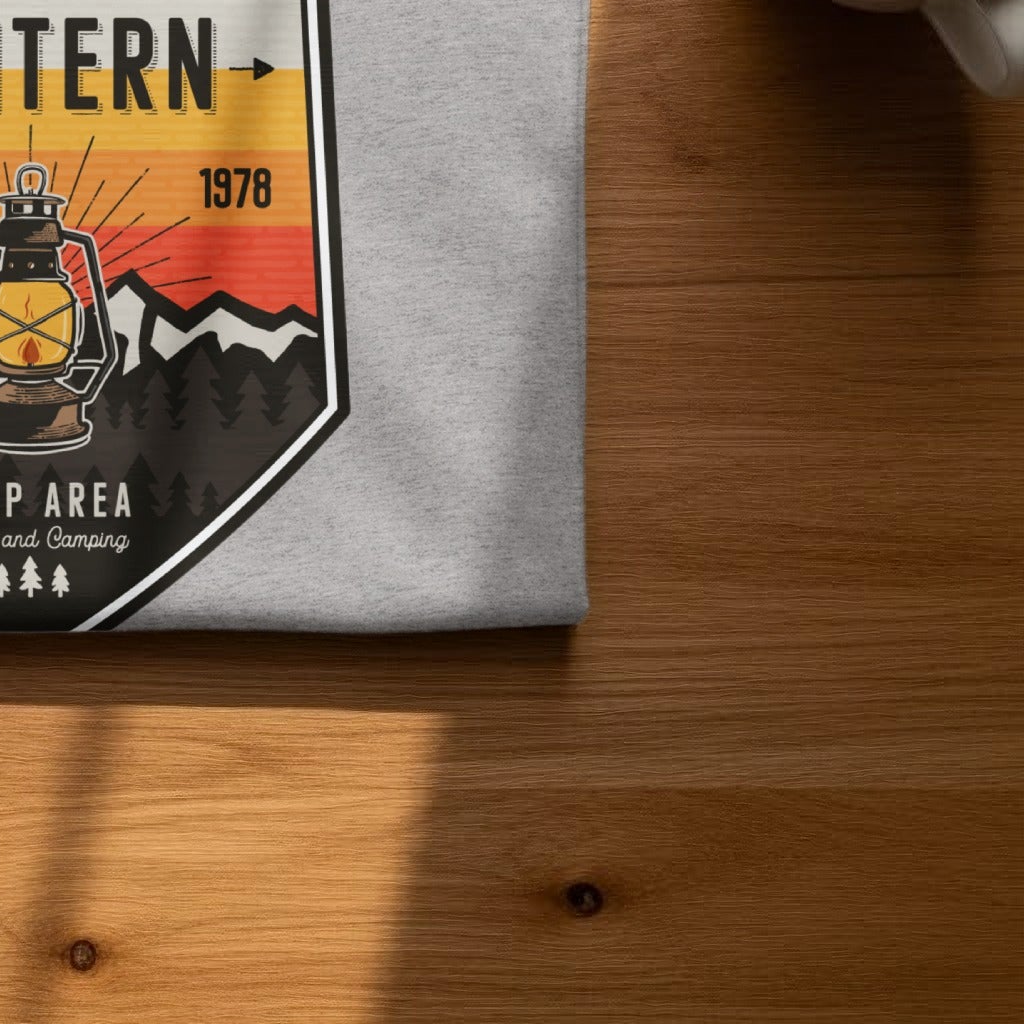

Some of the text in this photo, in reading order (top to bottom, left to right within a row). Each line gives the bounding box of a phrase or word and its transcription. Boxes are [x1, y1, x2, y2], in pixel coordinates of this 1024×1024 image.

[199, 168, 272, 209] 1978
[44, 482, 131, 517] AREA
[1, 529, 39, 548] and
[46, 526, 130, 553] Camping
